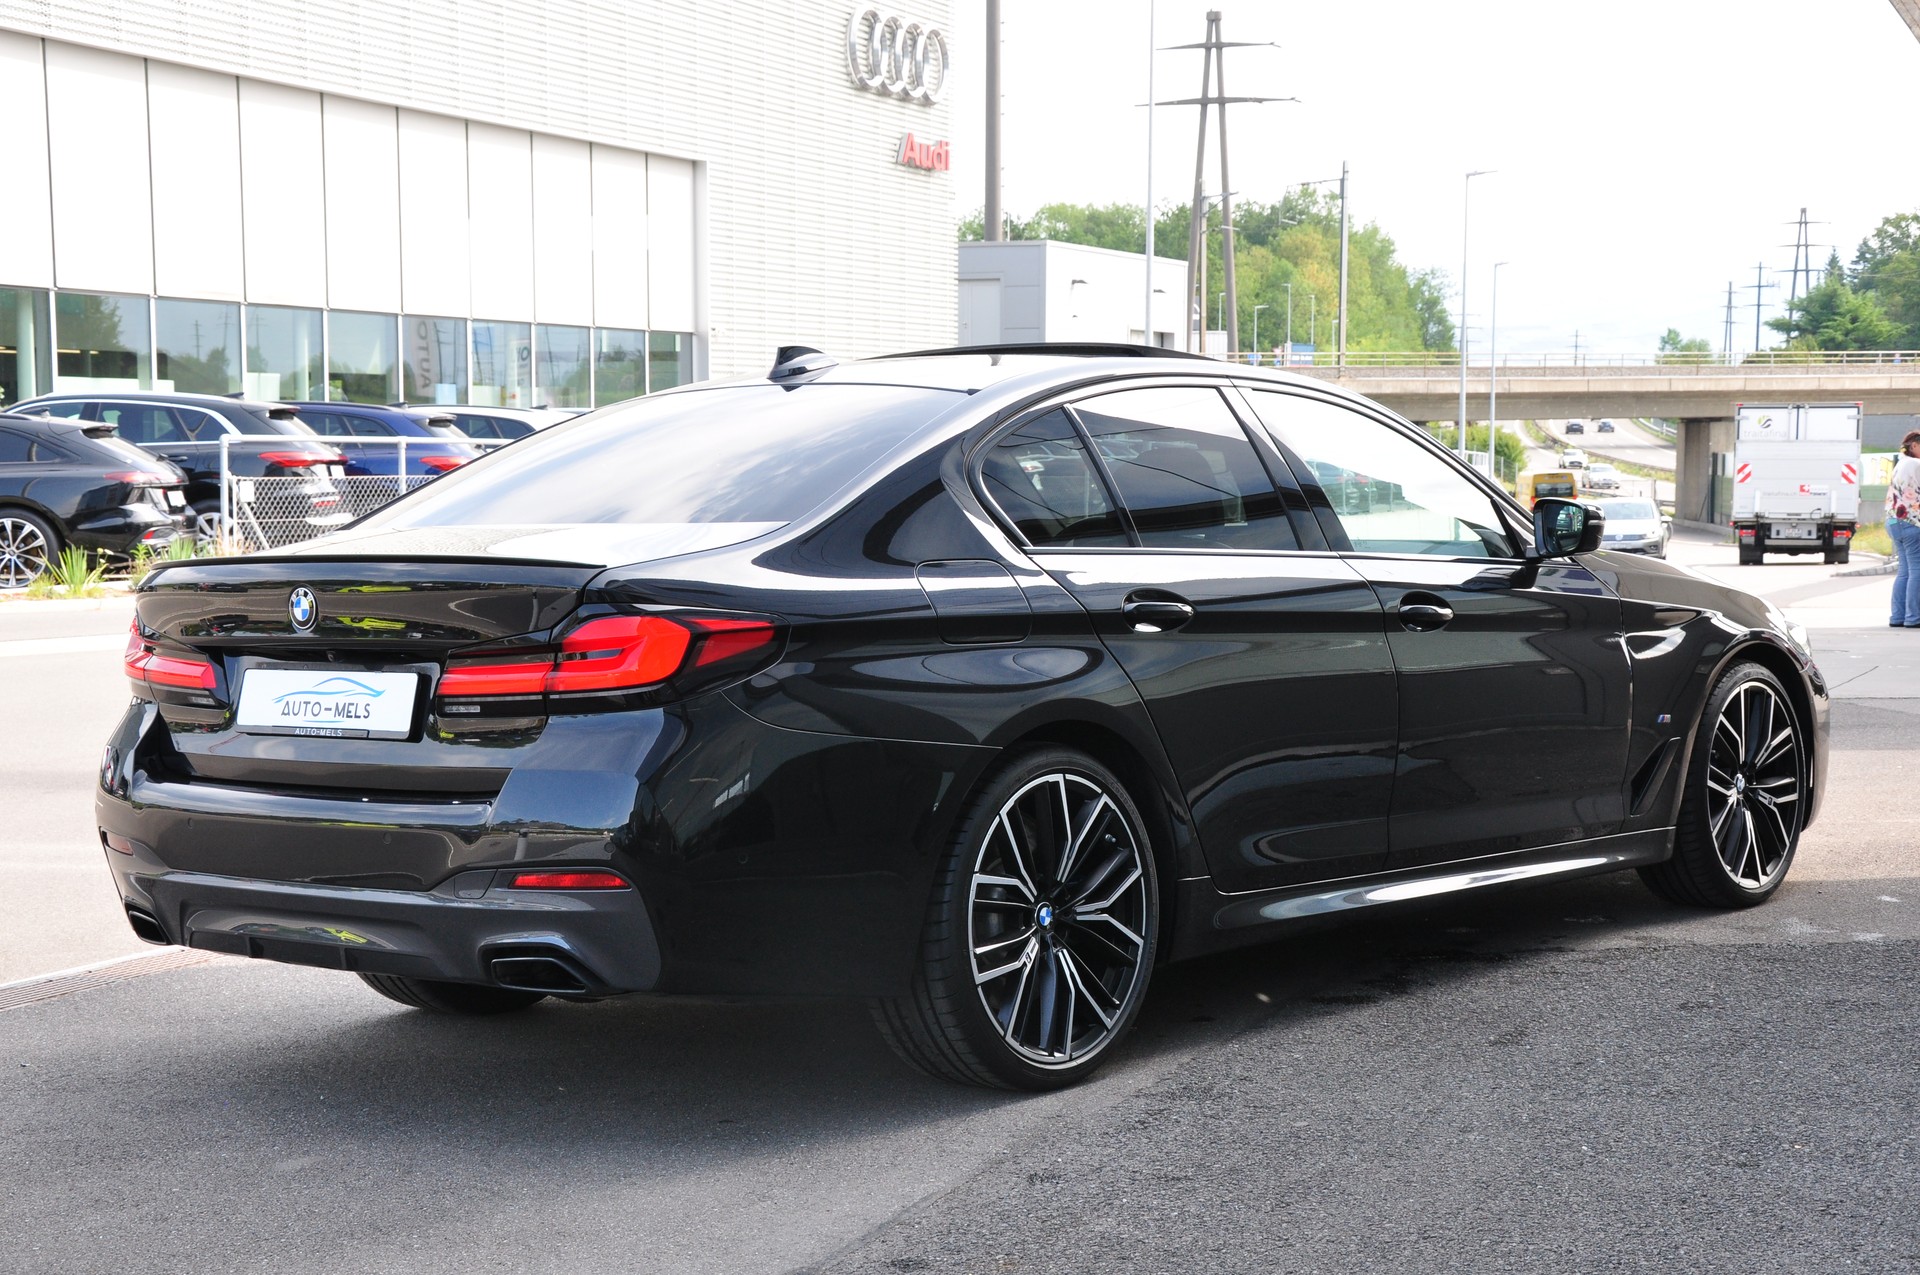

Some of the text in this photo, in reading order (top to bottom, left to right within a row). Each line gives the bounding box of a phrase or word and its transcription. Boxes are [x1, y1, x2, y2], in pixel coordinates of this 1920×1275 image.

[901, 132, 950, 171] Audi
[281, 700, 371, 719] AUTO-MELS
[294, 728, 343, 737] AUTO-MELS
